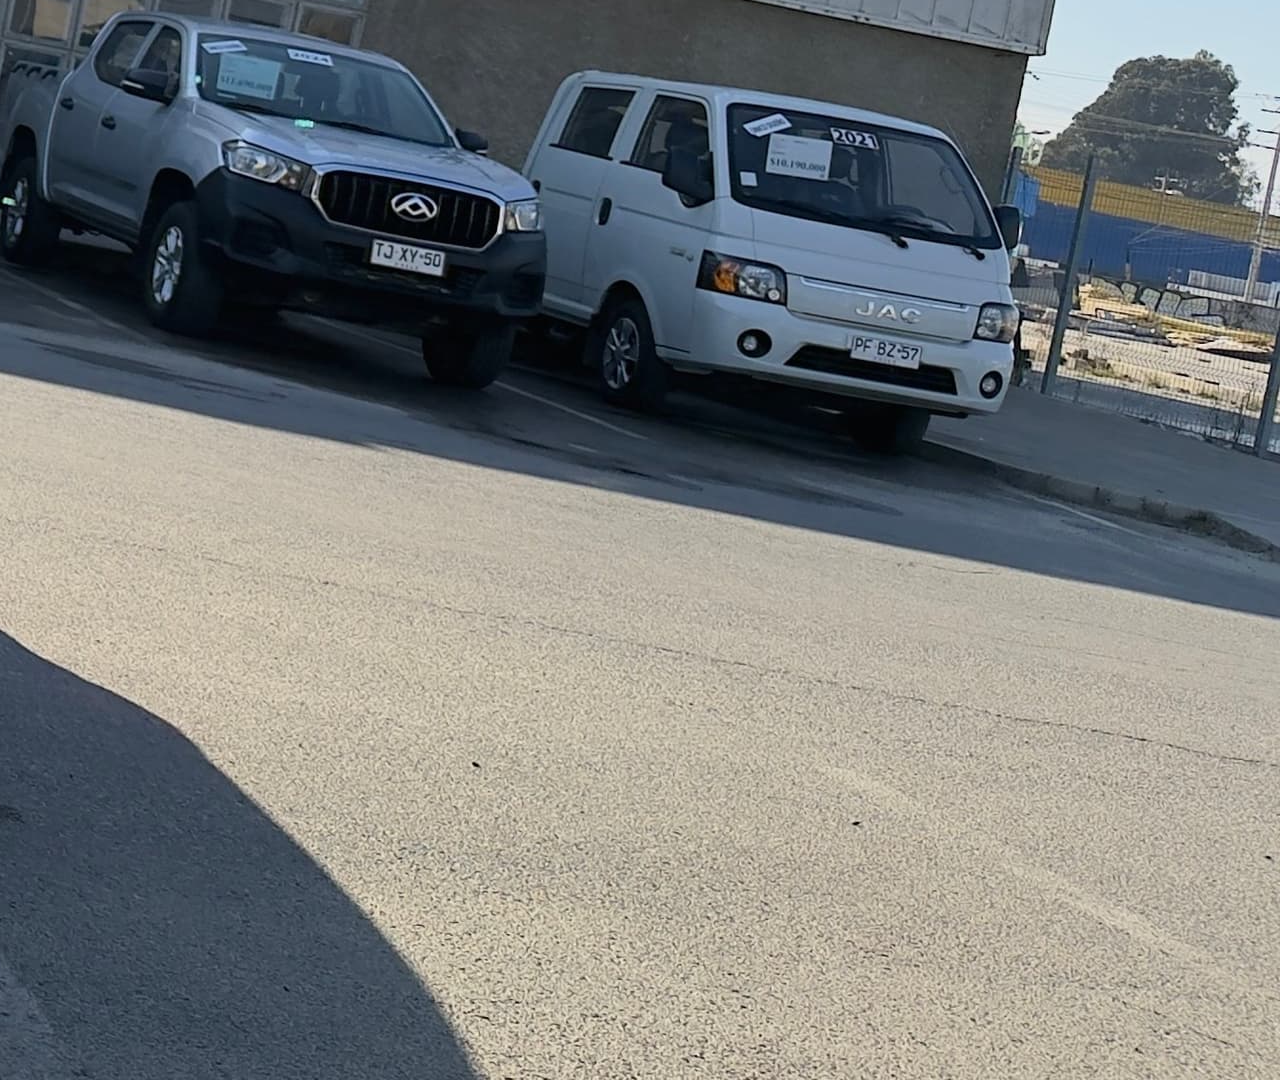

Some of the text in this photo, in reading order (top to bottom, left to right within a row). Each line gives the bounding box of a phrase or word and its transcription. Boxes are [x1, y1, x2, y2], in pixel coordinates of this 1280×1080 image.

[832, 128, 878, 149] 2021
[375, 241, 394, 260] TJ
[855, 301, 921, 325] JAC
[854, 337, 873, 353] PF
